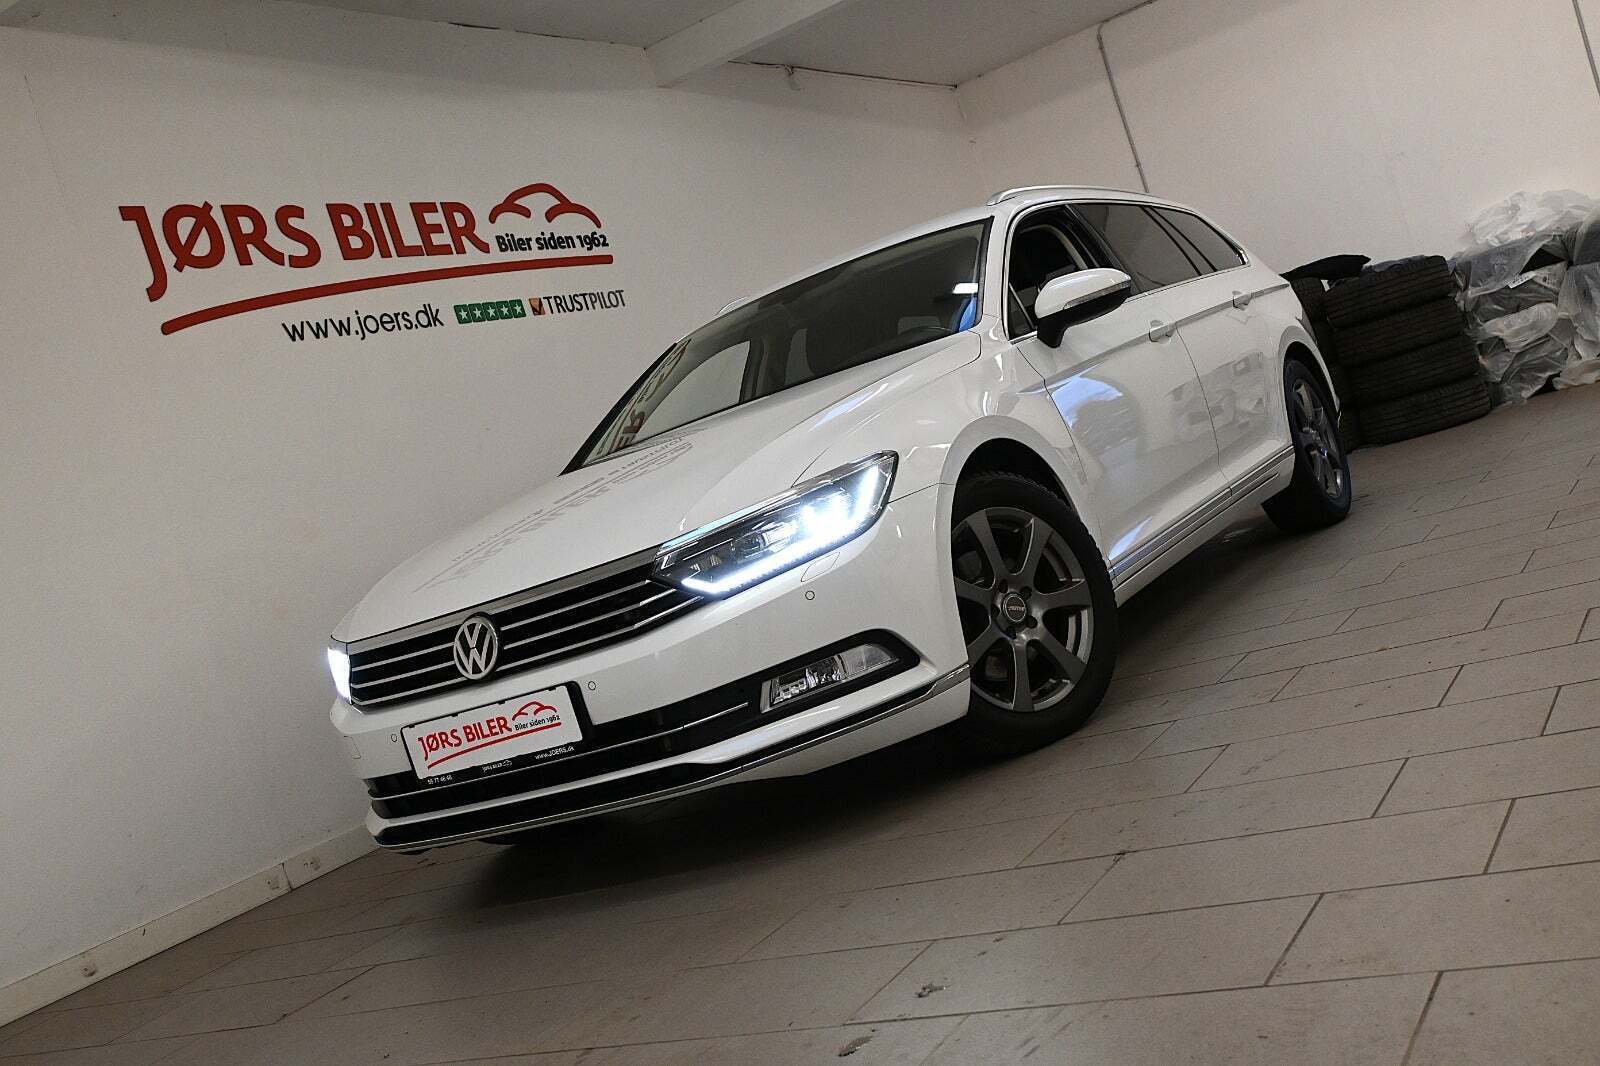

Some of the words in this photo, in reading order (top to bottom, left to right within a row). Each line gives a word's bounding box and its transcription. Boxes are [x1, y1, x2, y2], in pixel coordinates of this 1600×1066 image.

[119, 200, 322, 302] JØRS
[327, 202, 491, 261] BILER
[495, 232, 533, 253] Biler
[535, 231, 577, 251] siden
[576, 231, 610, 251] 1962
[543, 289, 627, 315] TRUSTPILOT
[281, 303, 445, 342] www.joers.dk
[417, 728, 463, 762] JØRS
[463, 715, 513, 744] BILER
[514, 722, 529, 731] Biler
[529, 718, 546, 728] siden
